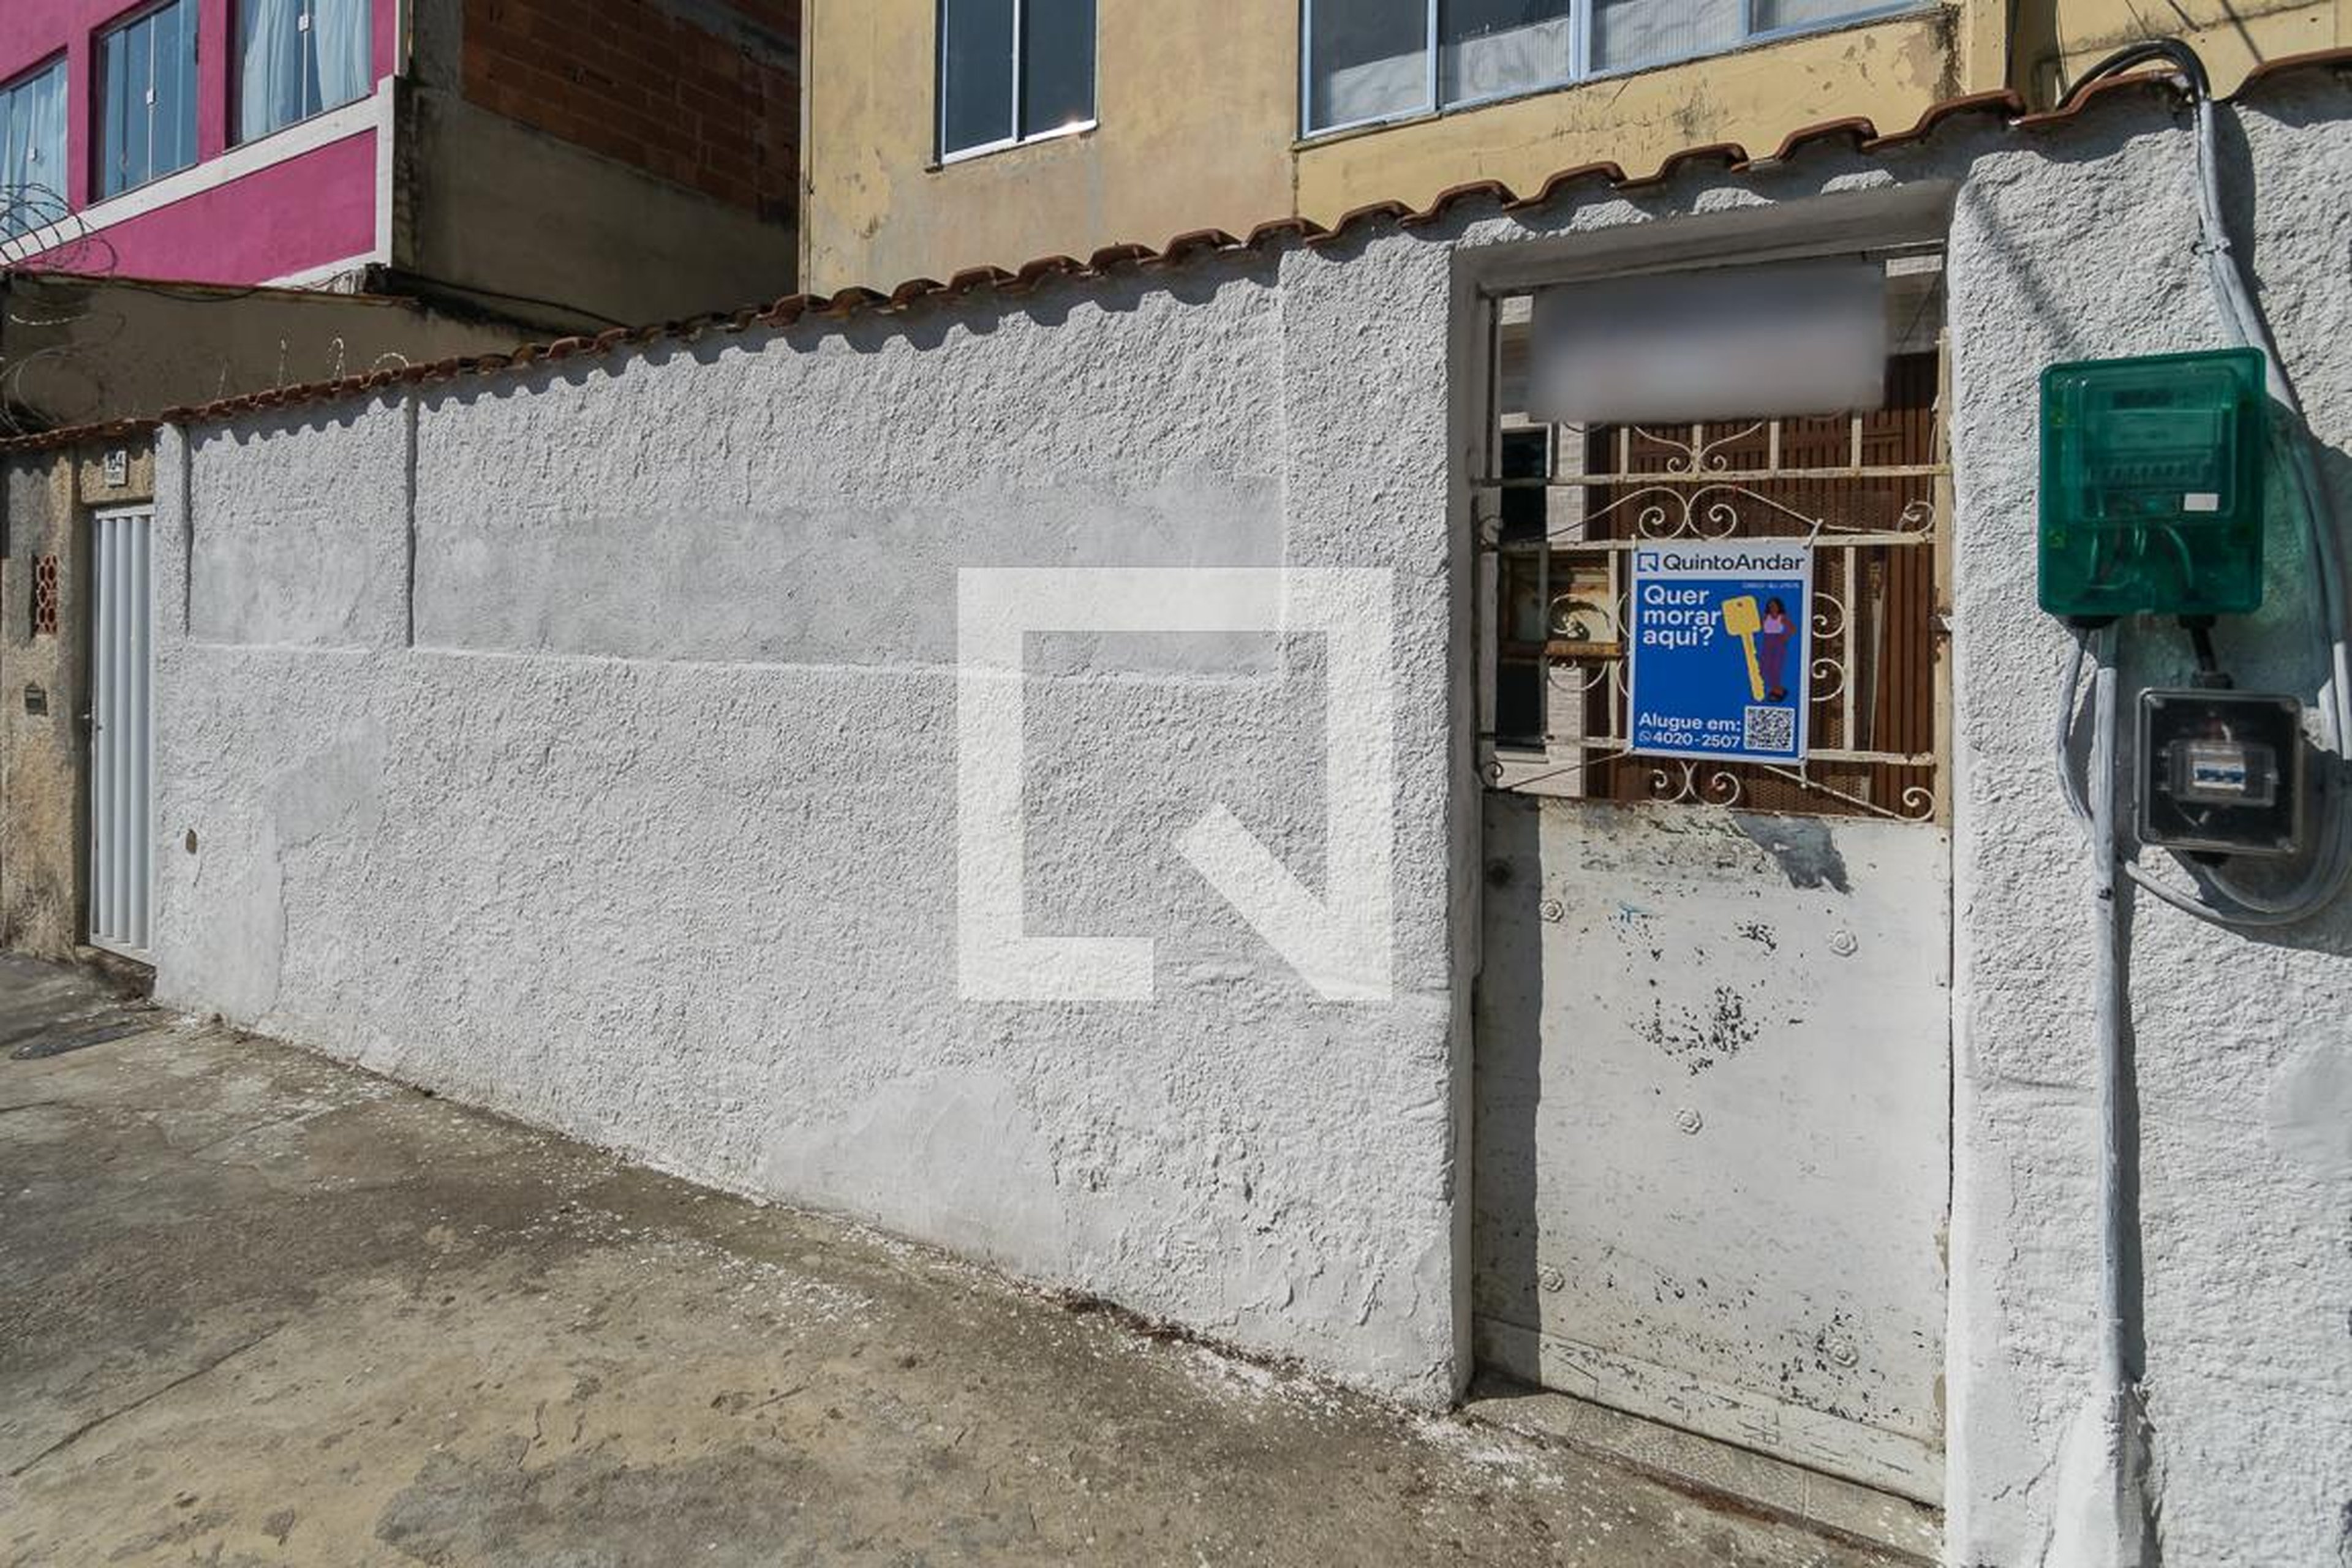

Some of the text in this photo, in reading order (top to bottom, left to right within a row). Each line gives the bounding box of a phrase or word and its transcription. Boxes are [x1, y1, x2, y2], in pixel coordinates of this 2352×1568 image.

[1663, 554, 1804, 571] QuintoAndar
[1644, 585, 1709, 606] Quer
[1643, 609, 1721, 626] morar
[1643, 627, 1714, 649] aqui?
[1638, 712, 1741, 733] Alugue em:
[1653, 731, 1741, 748] 4020-2507
